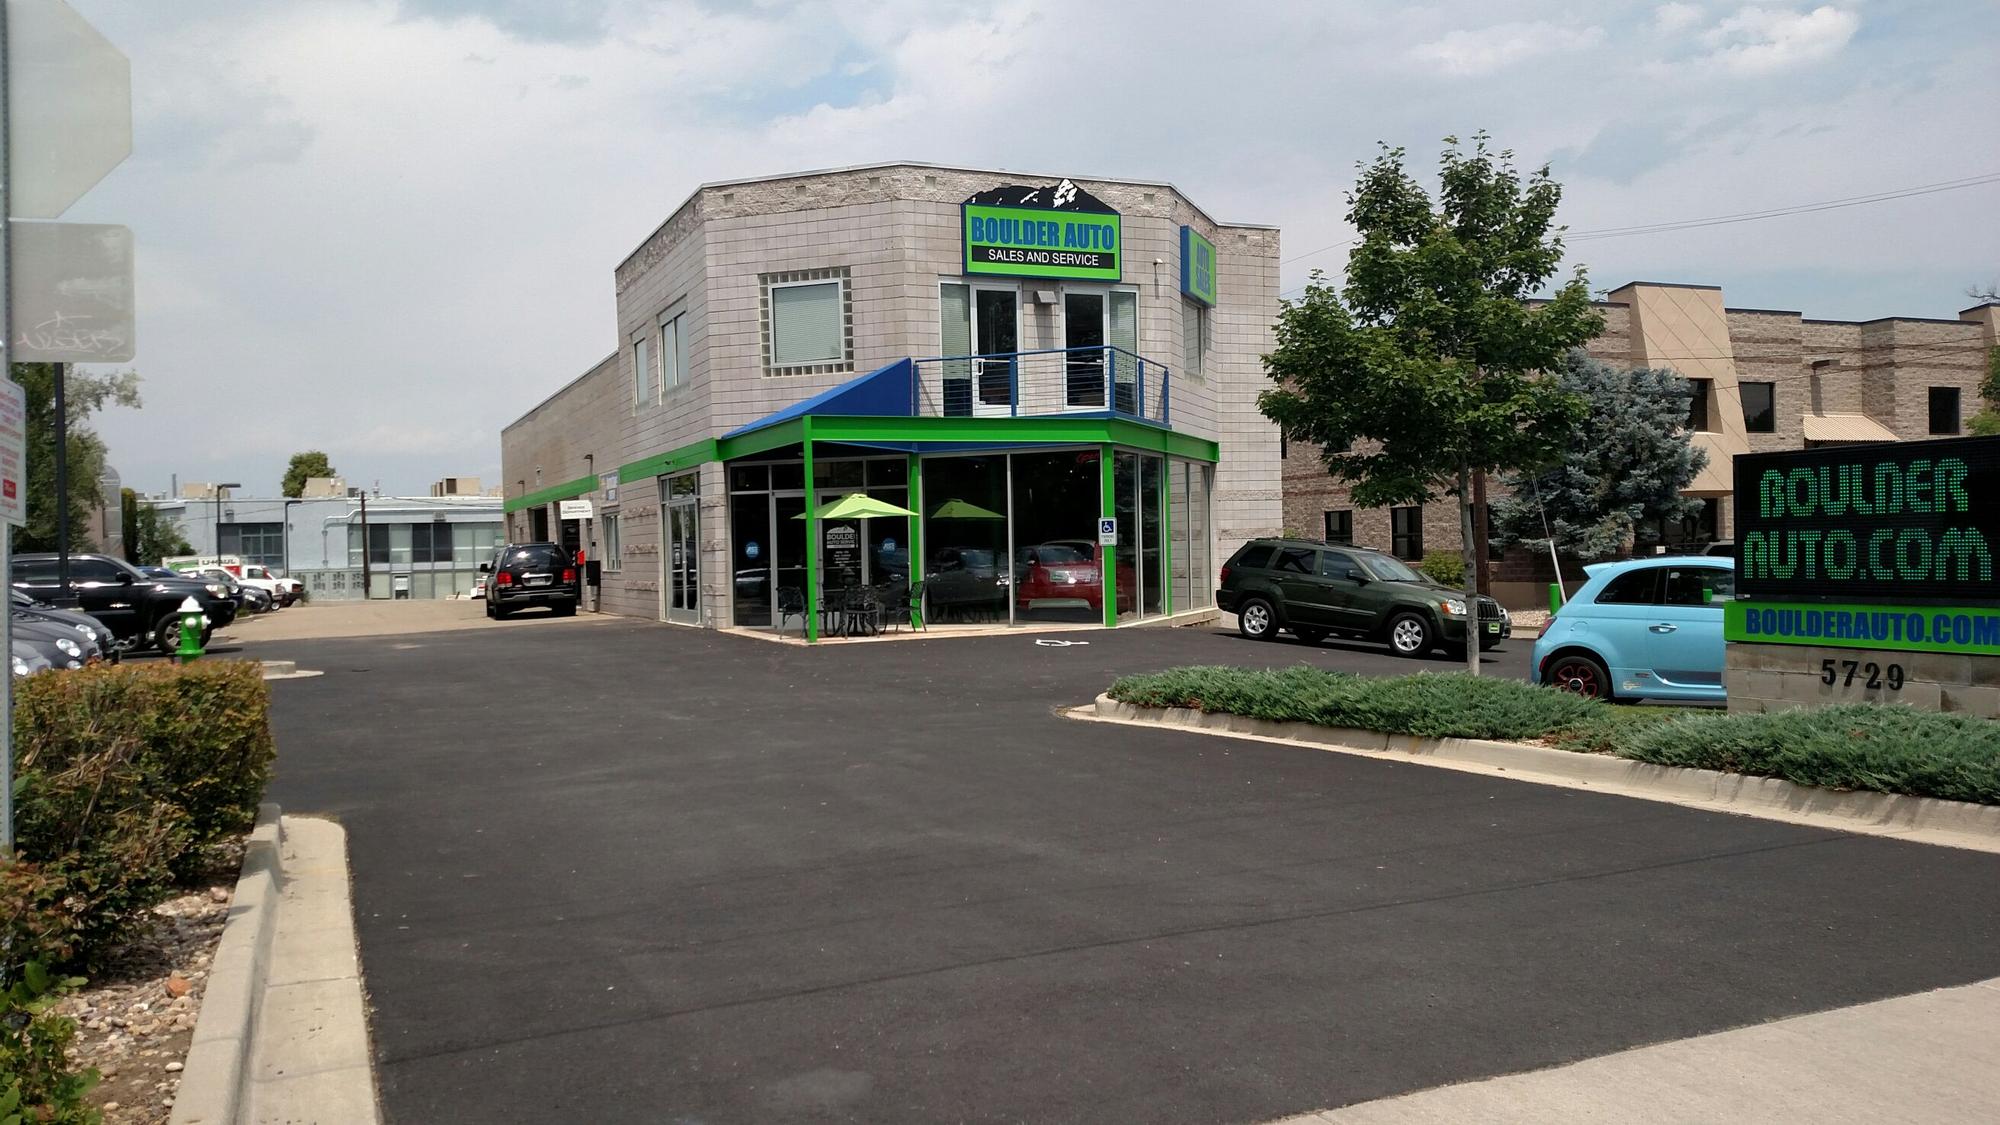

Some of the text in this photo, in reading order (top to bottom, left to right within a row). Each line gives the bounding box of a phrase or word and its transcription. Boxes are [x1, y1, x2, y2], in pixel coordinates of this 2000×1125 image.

[971, 216, 1115, 250] BOULDER AUTO
[988, 248, 1099, 266] SALES AND SERVICE
[1743, 526, 1992, 581] AUTO.COM
[1745, 608, 2000, 647] BOULDERAUTO.COM
[1821, 659, 1905, 690] 5729
